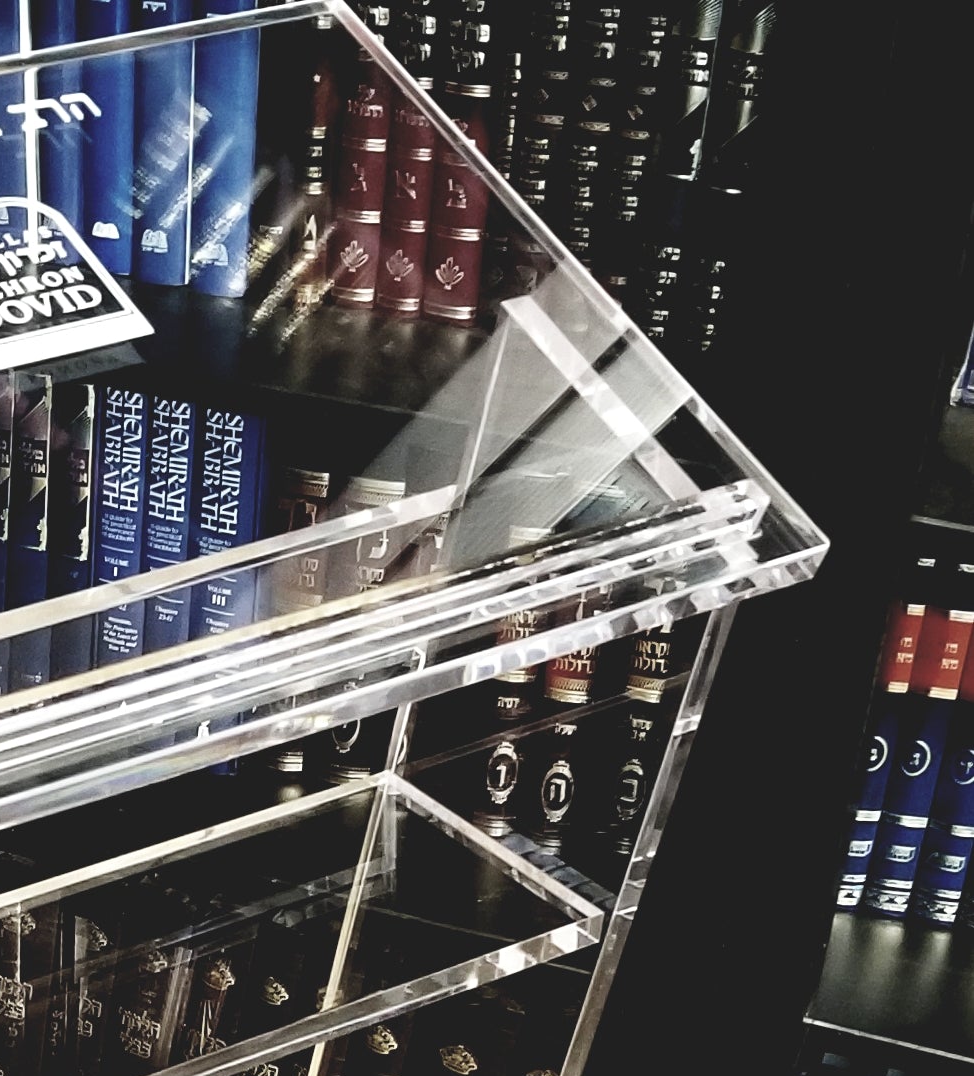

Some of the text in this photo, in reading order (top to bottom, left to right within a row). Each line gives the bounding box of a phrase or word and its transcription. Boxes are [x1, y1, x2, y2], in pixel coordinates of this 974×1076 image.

[102, 386, 123, 510] SHABBATH
[120, 390, 144, 513] SHEMIRATH
[148, 396, 171, 520] SHABBATH
[166, 400, 191, 523] SHEMIRATH
[200, 408, 224, 533] SHABBATH
[218, 412, 244, 536] SHEMIRATH
[212, 594, 226, 606] III
